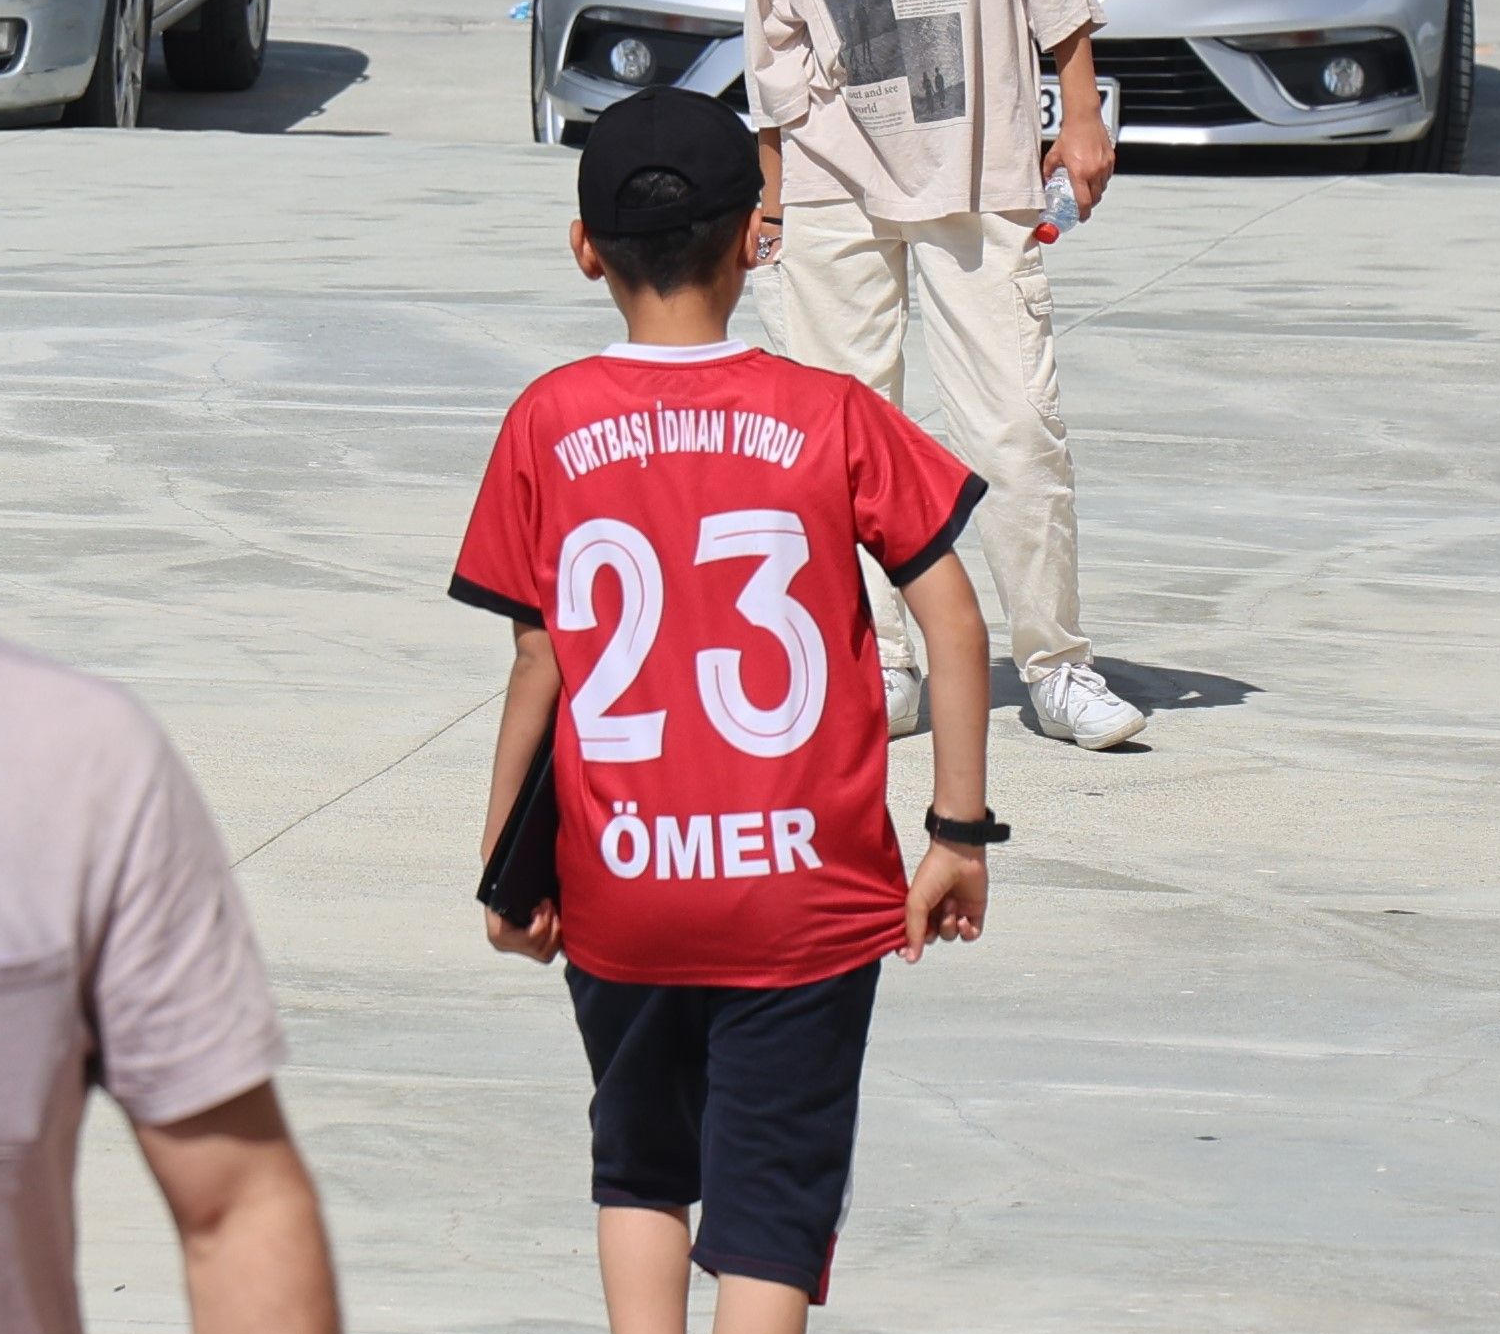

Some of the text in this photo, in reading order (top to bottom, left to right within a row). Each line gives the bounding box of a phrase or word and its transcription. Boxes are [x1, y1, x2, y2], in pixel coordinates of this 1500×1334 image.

[864, 85, 883, 99] and
[884, 84, 898, 94] see
[554, 400, 805, 481] YURTBAŞI İDMAN YURDU
[557, 509, 828, 763] 23
[601, 800, 823, 880] ÖMER
